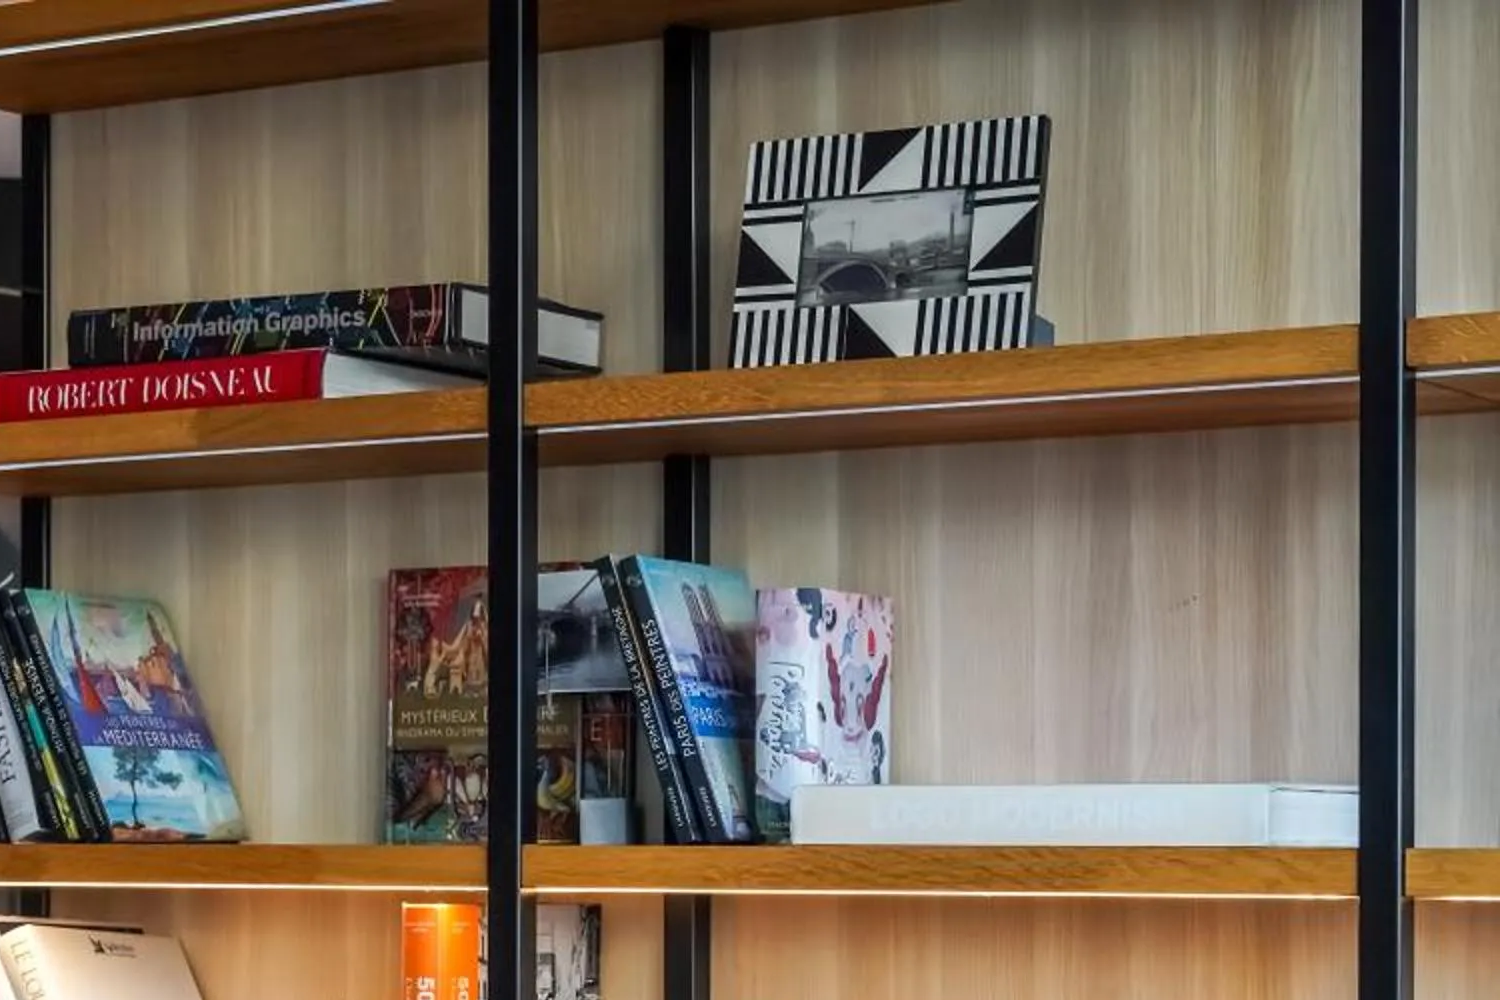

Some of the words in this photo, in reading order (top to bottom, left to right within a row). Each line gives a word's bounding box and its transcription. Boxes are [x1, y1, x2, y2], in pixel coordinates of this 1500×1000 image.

[133, 313, 260, 343] Information
[265, 306, 367, 334] Graphics
[28, 378, 134, 414] ROBERT
[143, 366, 277, 403] DOISNEAU
[641, 618, 674, 688] PEINTRES
[672, 713, 696, 757] PARIS
[10, 939, 33, 963] LE
